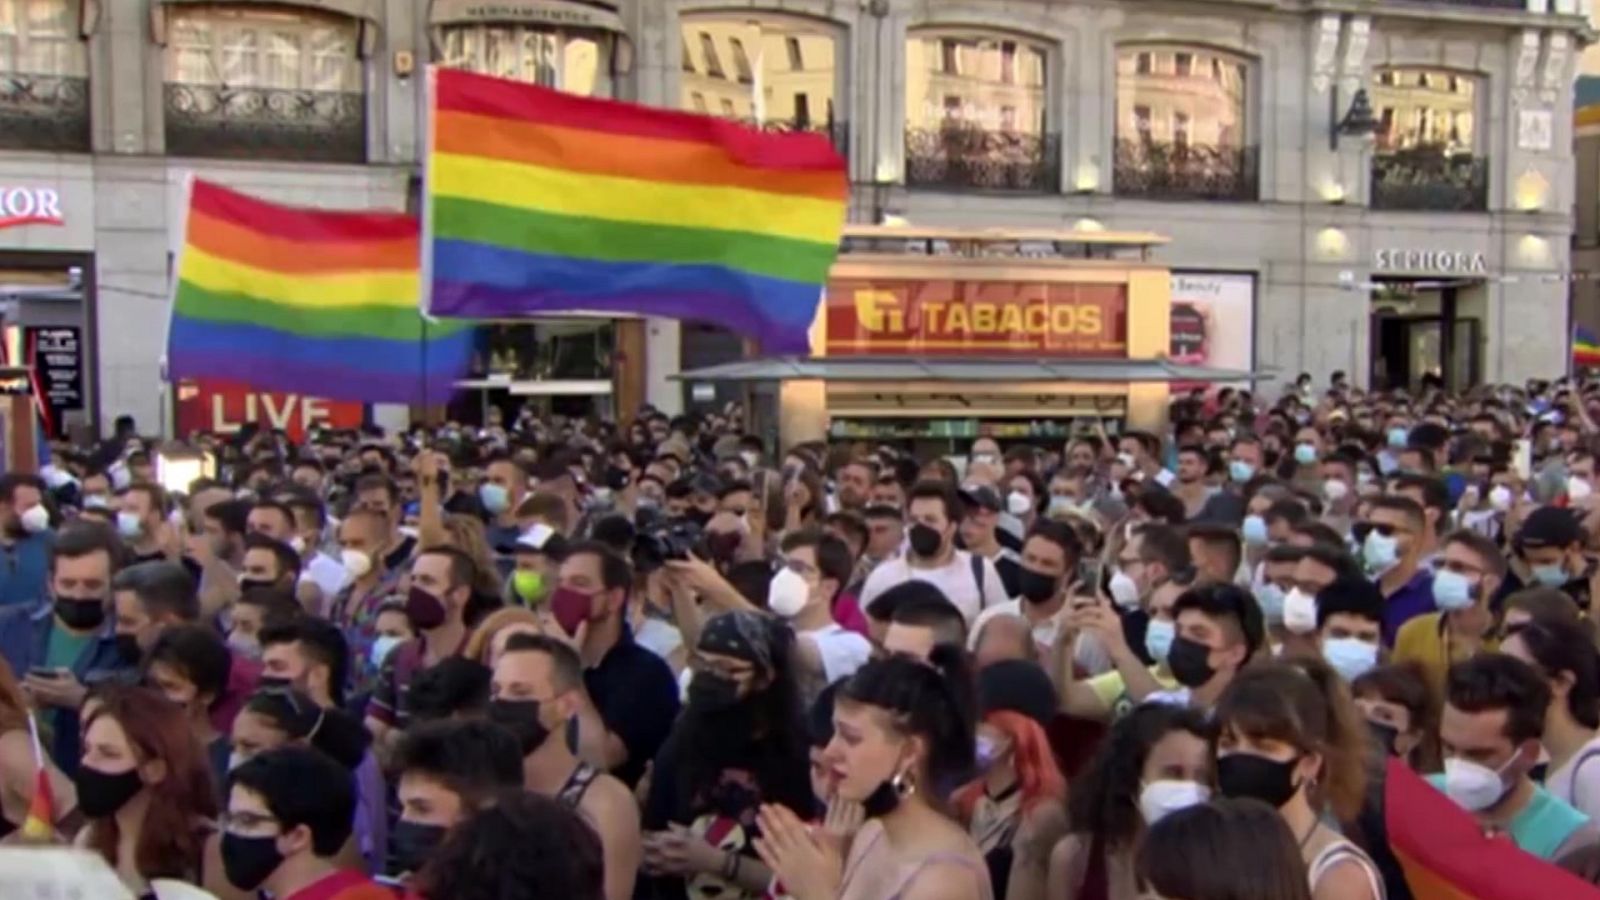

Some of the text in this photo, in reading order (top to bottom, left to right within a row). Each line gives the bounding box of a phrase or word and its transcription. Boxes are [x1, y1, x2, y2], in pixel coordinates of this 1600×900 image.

[1375, 249, 1486, 273] SEPHORA
[922, 303, 1101, 334] TABACOS
[212, 393, 333, 433] LIVE
